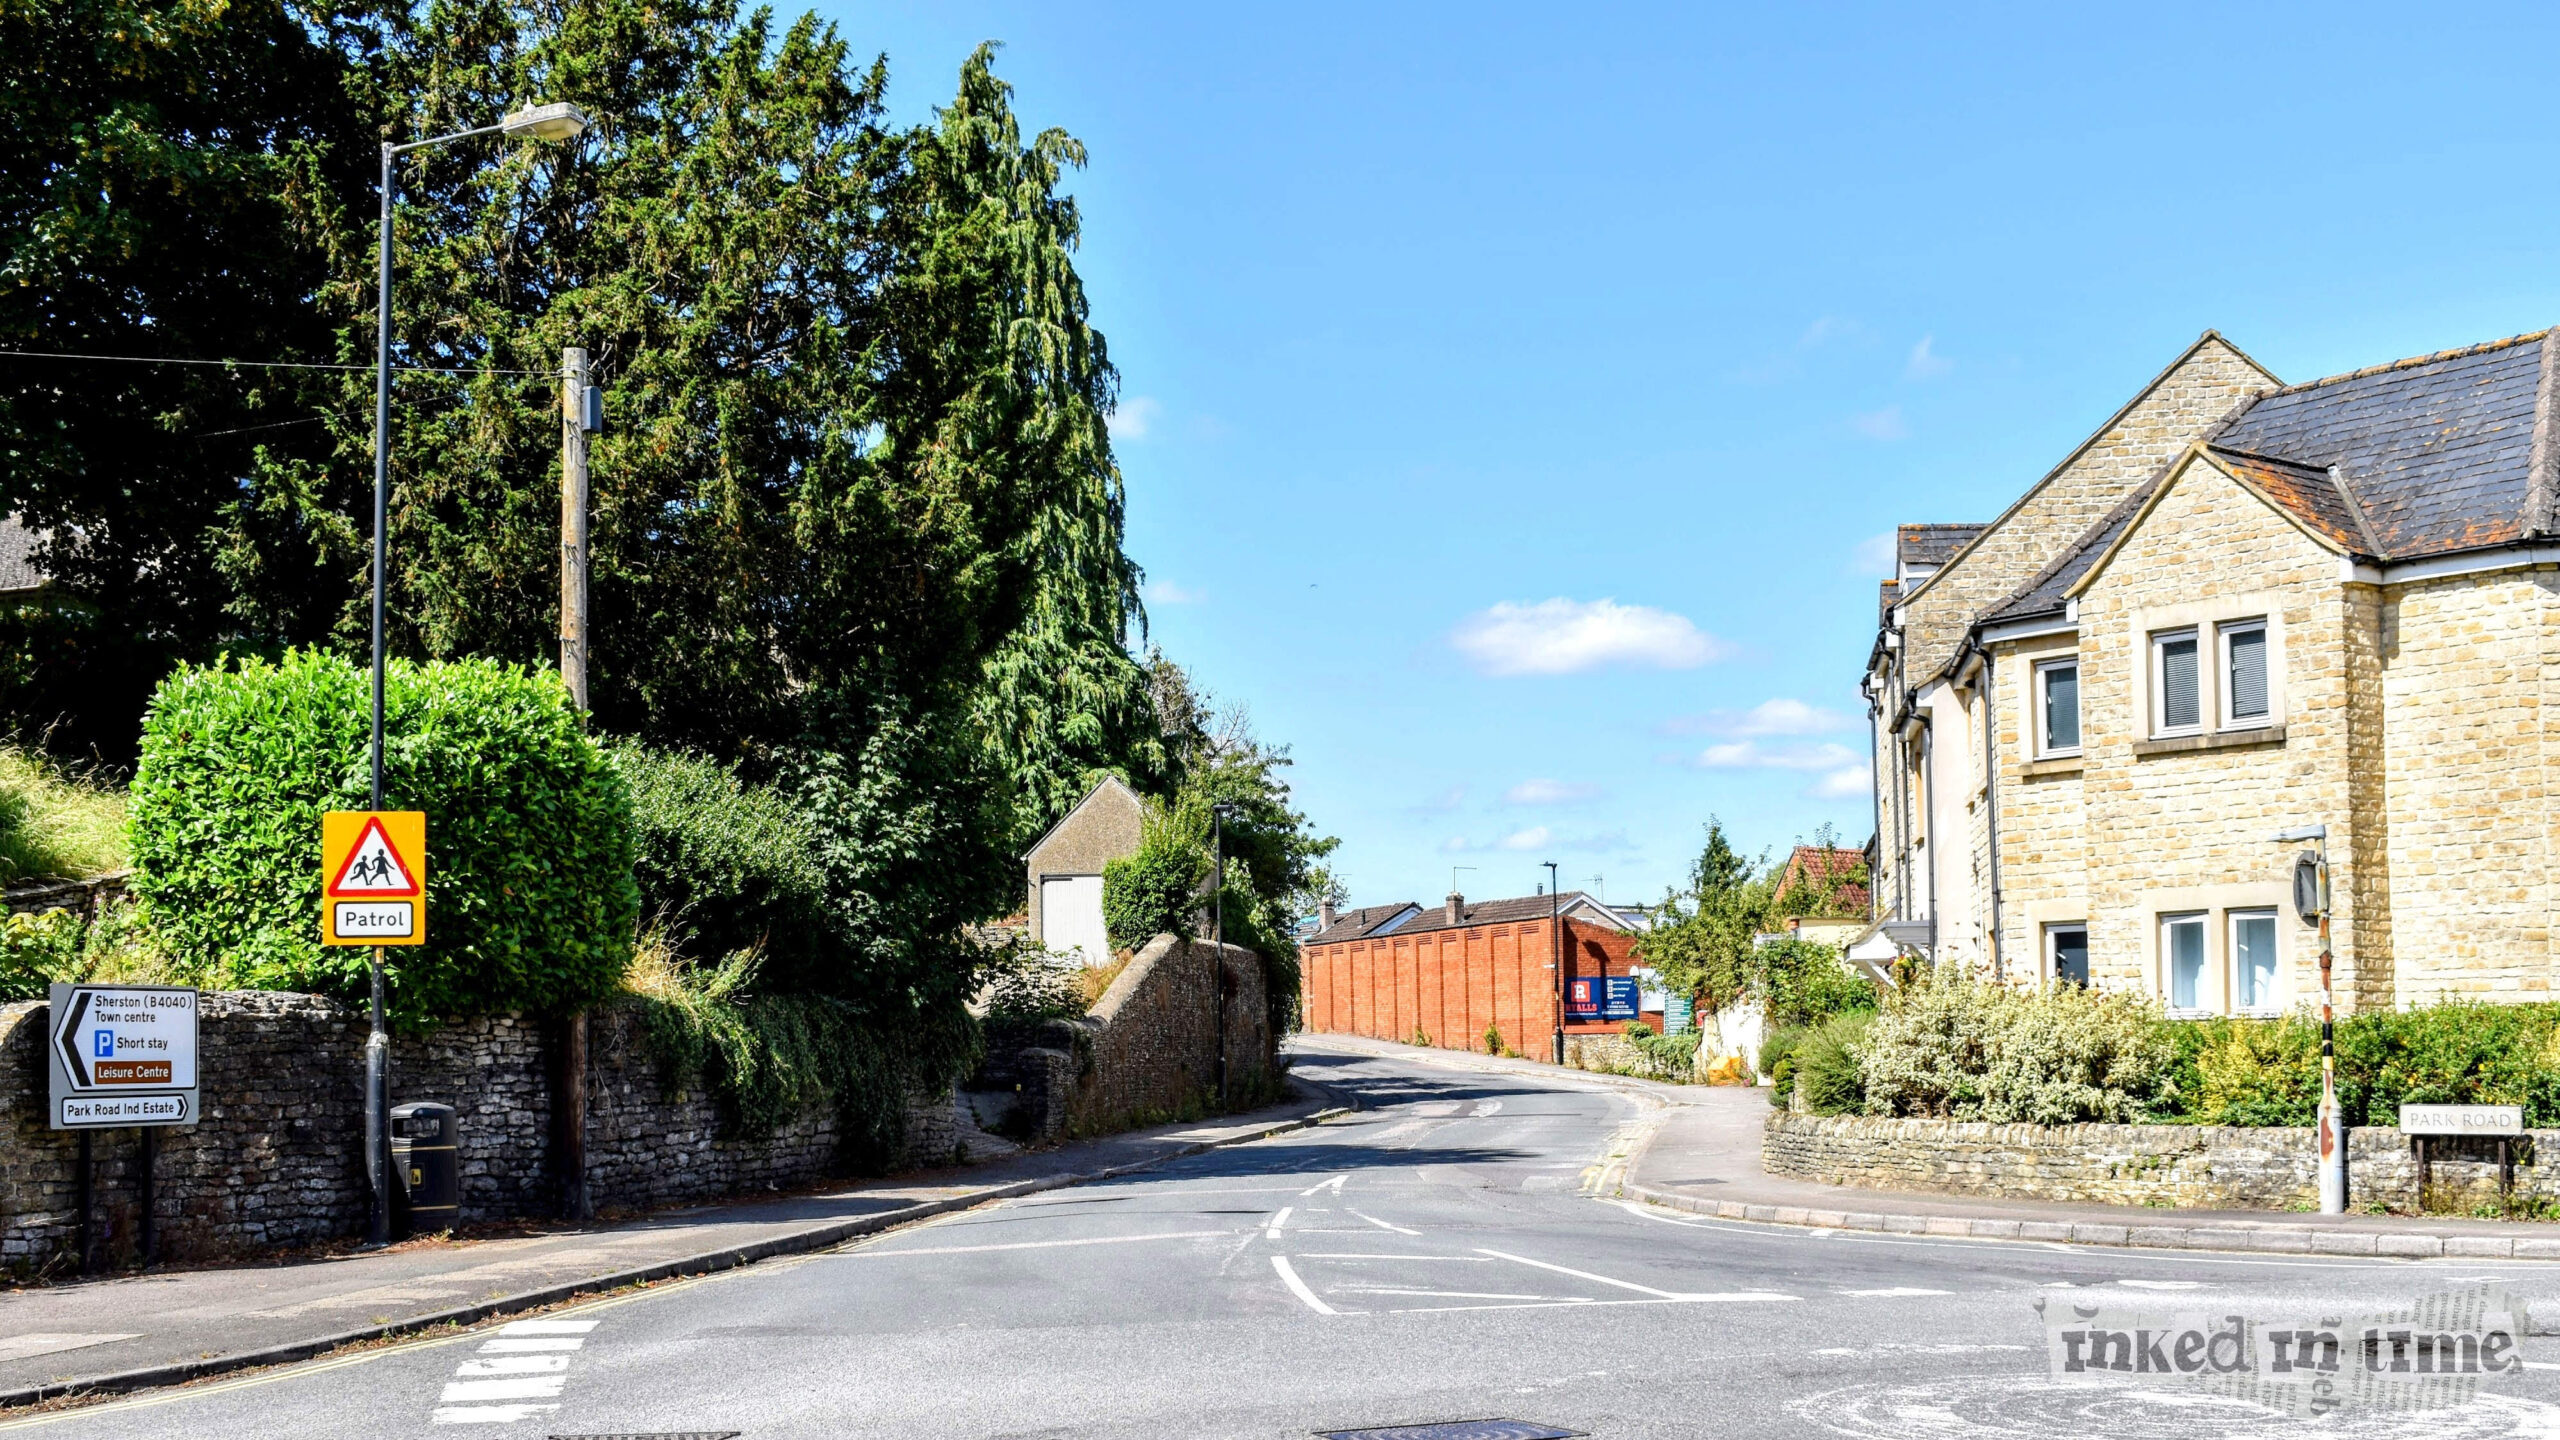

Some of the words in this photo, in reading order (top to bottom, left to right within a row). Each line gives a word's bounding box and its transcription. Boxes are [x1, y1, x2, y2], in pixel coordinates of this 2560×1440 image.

[346, 911, 404, 927] Patrol
[1574, 984, 1586, 999] R
[95, 995, 140, 1008] Sherston
[144, 995, 192, 1010] (B4040)
[95, 1010, 121, 1023] Town
[124, 1012, 156, 1023] centre
[98, 1032, 111, 1055] P
[117, 1037, 145, 1049] Short
[148, 1038, 168, 1050] stay
[98, 1066, 133, 1079] Leisure
[136, 1065, 169, 1078] Centre
[67, 1104, 91, 1117] Park
[94, 1103, 120, 1115] Road
[124, 1103, 139, 1115] Ind
[143, 1102, 174, 1114] Estate
[2410, 1112, 2455, 1127] PARK
[2462, 1113, 2511, 1128] ROAD
